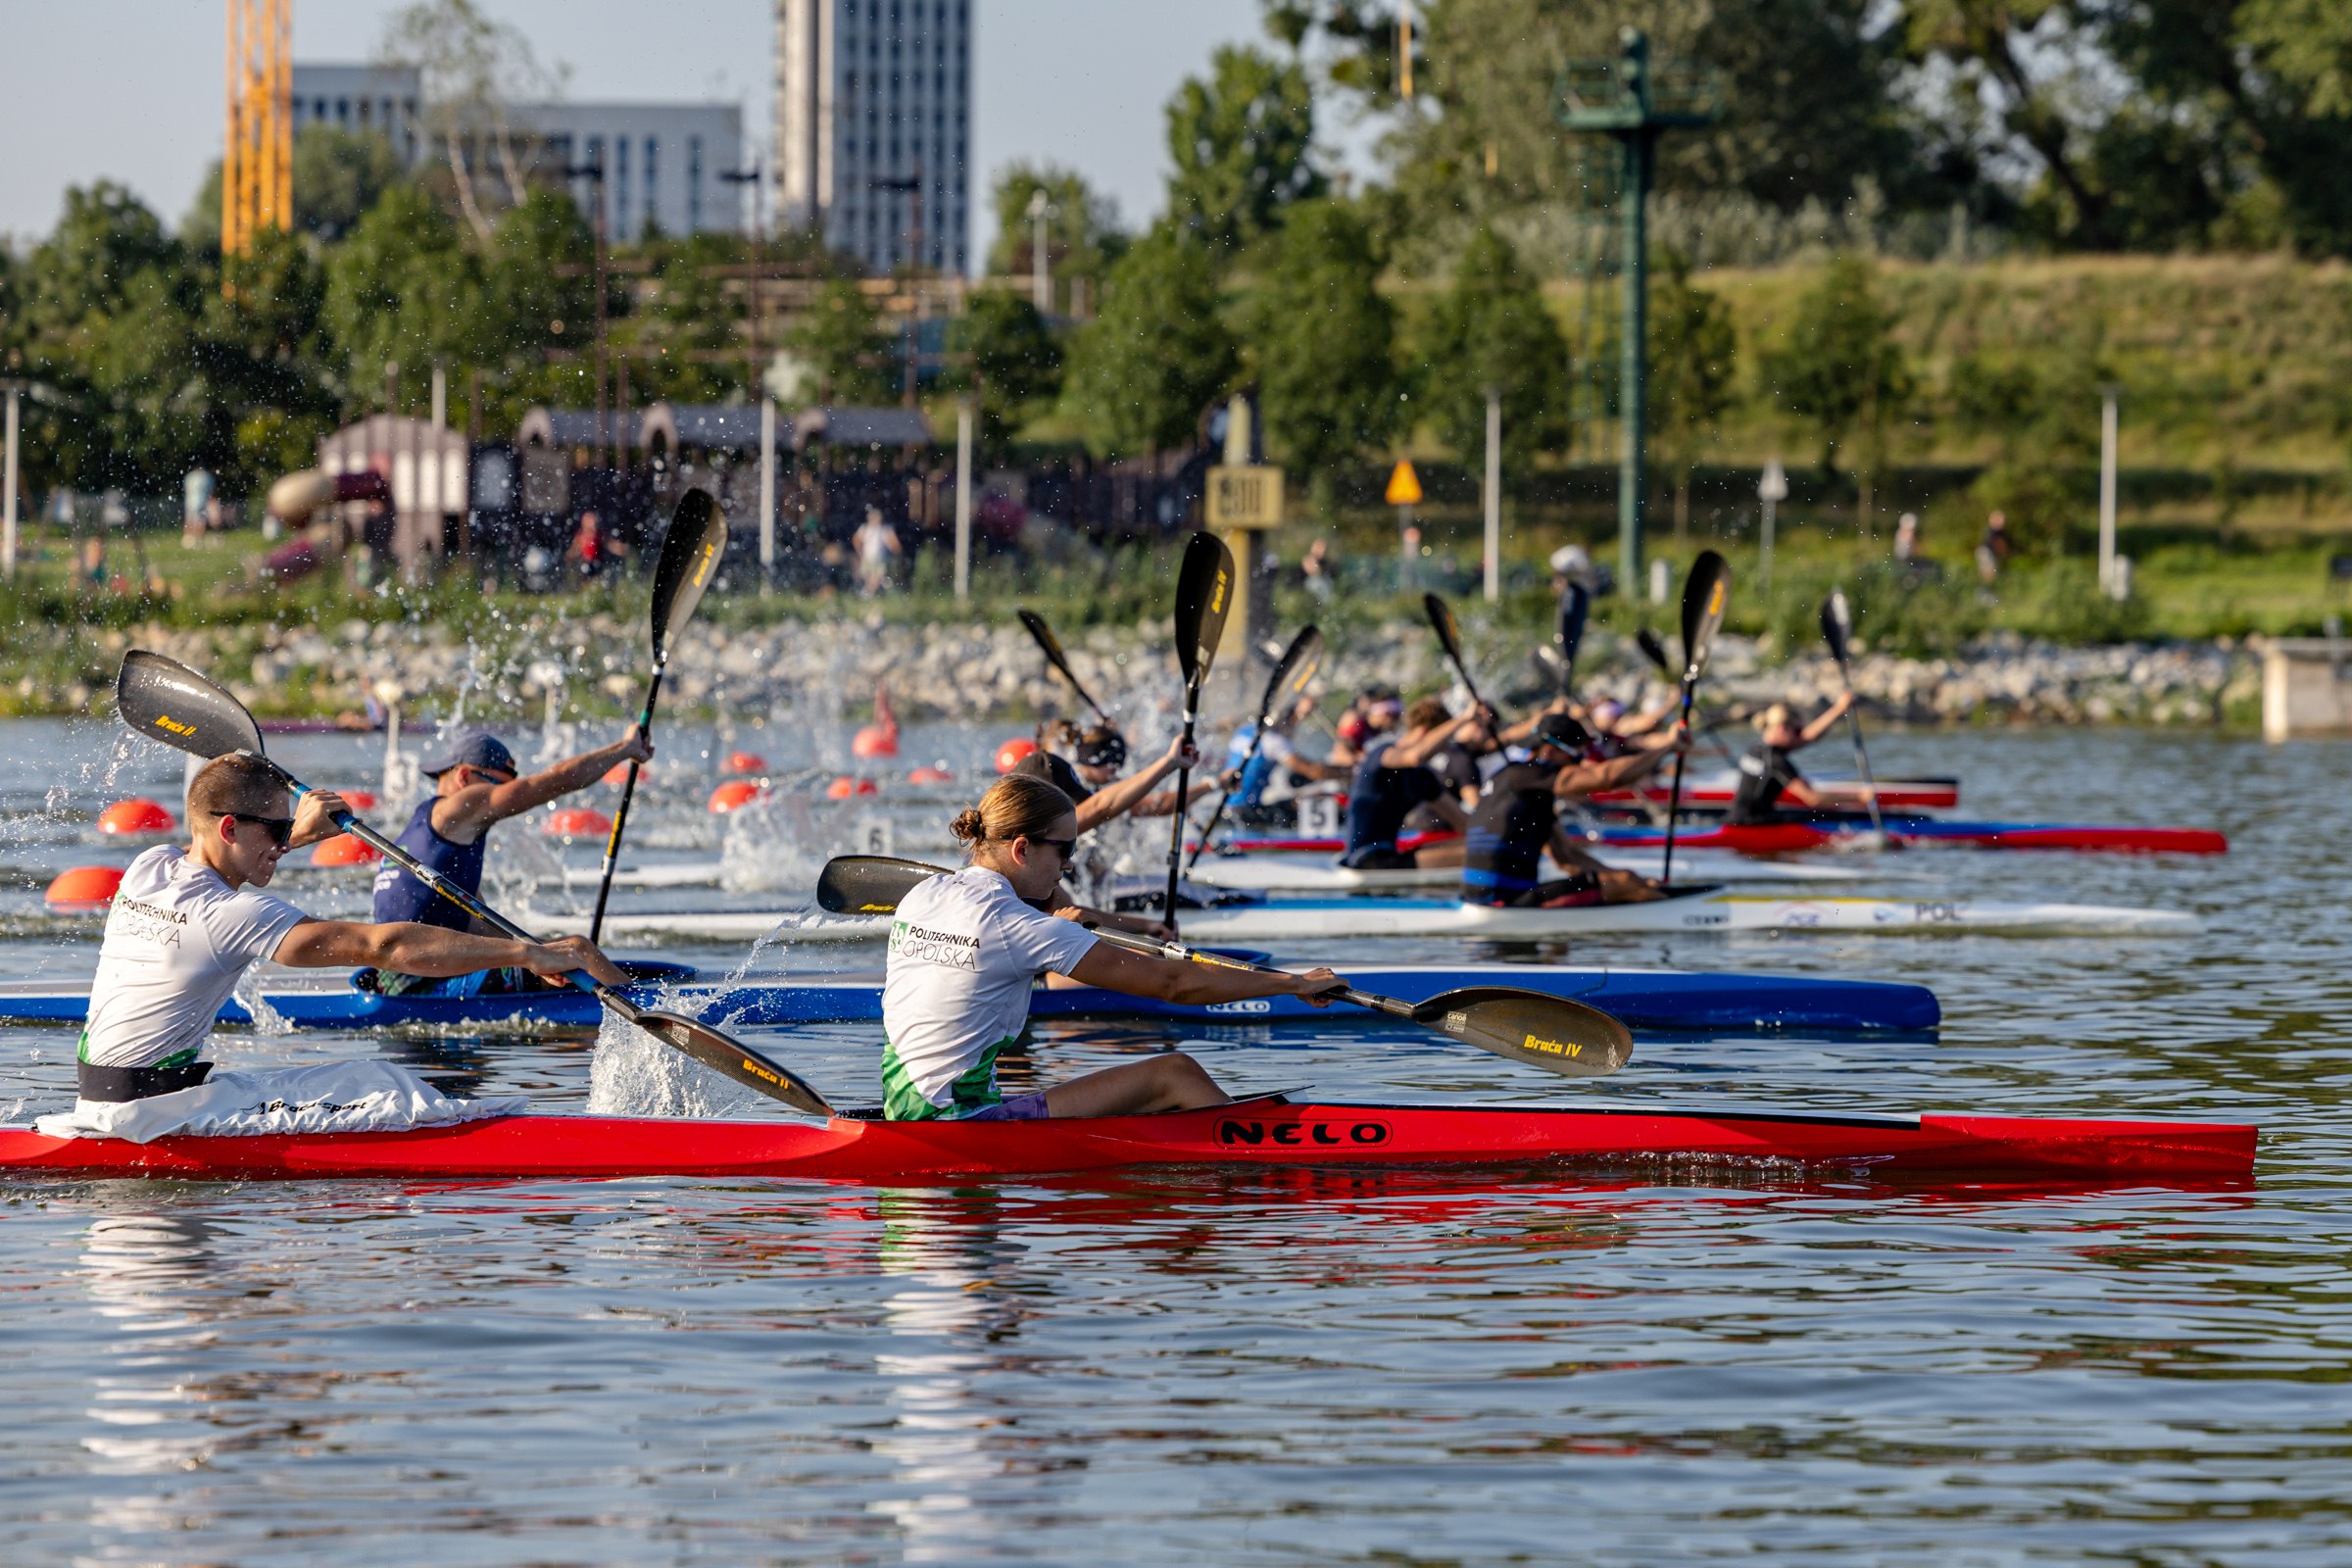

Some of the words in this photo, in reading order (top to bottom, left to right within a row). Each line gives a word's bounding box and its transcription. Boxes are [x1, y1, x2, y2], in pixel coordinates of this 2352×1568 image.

[1310, 799, 1327, 830] 5
[868, 826, 884, 855] 6
[122, 896, 188, 925] POLITECHNIKA
[908, 925, 980, 949] POLITECHNIKA
[903, 940, 976, 970] OPOLSKA
[1524, 1034, 1563, 1054] Braća
[1565, 1042, 1583, 1057] IV
[1221, 1121, 1388, 1145] NELO
